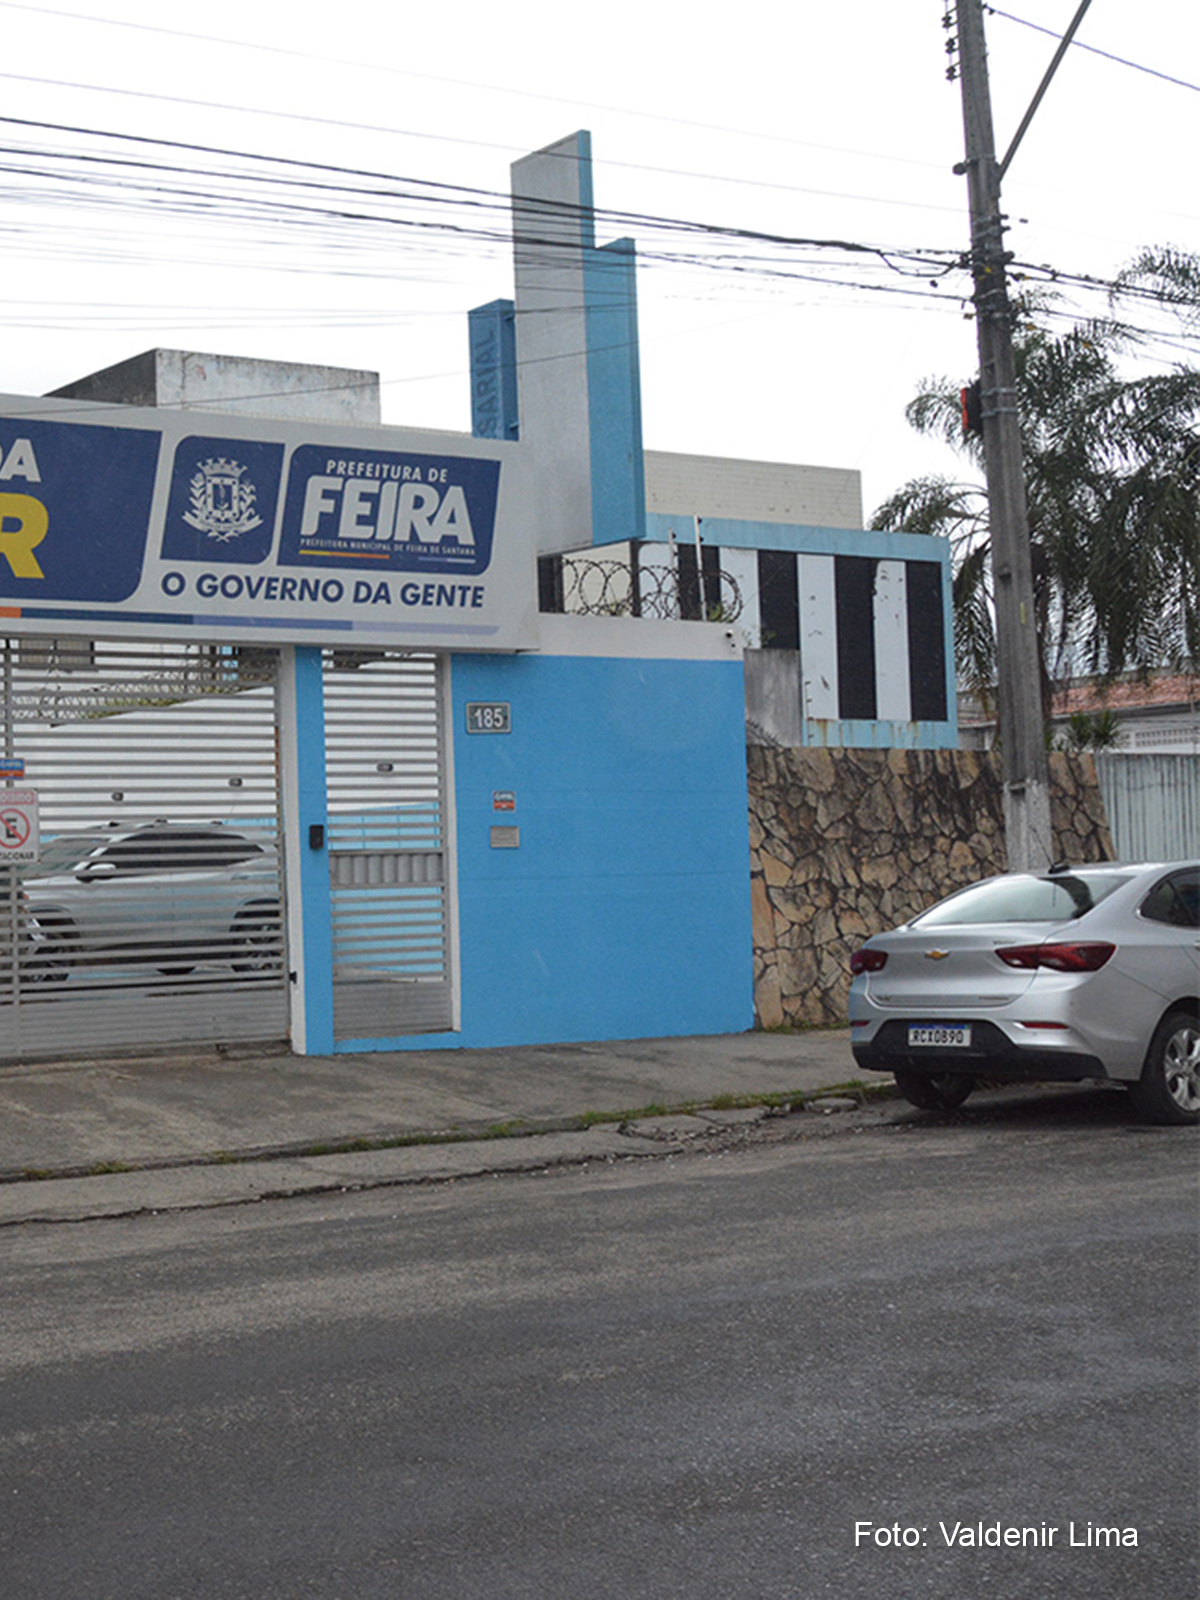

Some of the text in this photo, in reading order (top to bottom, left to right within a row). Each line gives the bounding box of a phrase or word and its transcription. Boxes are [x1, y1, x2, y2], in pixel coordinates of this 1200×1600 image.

[326, 458, 448, 484] PREFEITURA DE
[300, 474, 476, 546] FEIRA
[300, 538, 476, 556] PREFEITURA MUNICIPAL DE FEIRA DE SANTANA
[161, 571, 485, 608] O GOVERNO DA GENTE
[474, 708, 503, 728] 185
